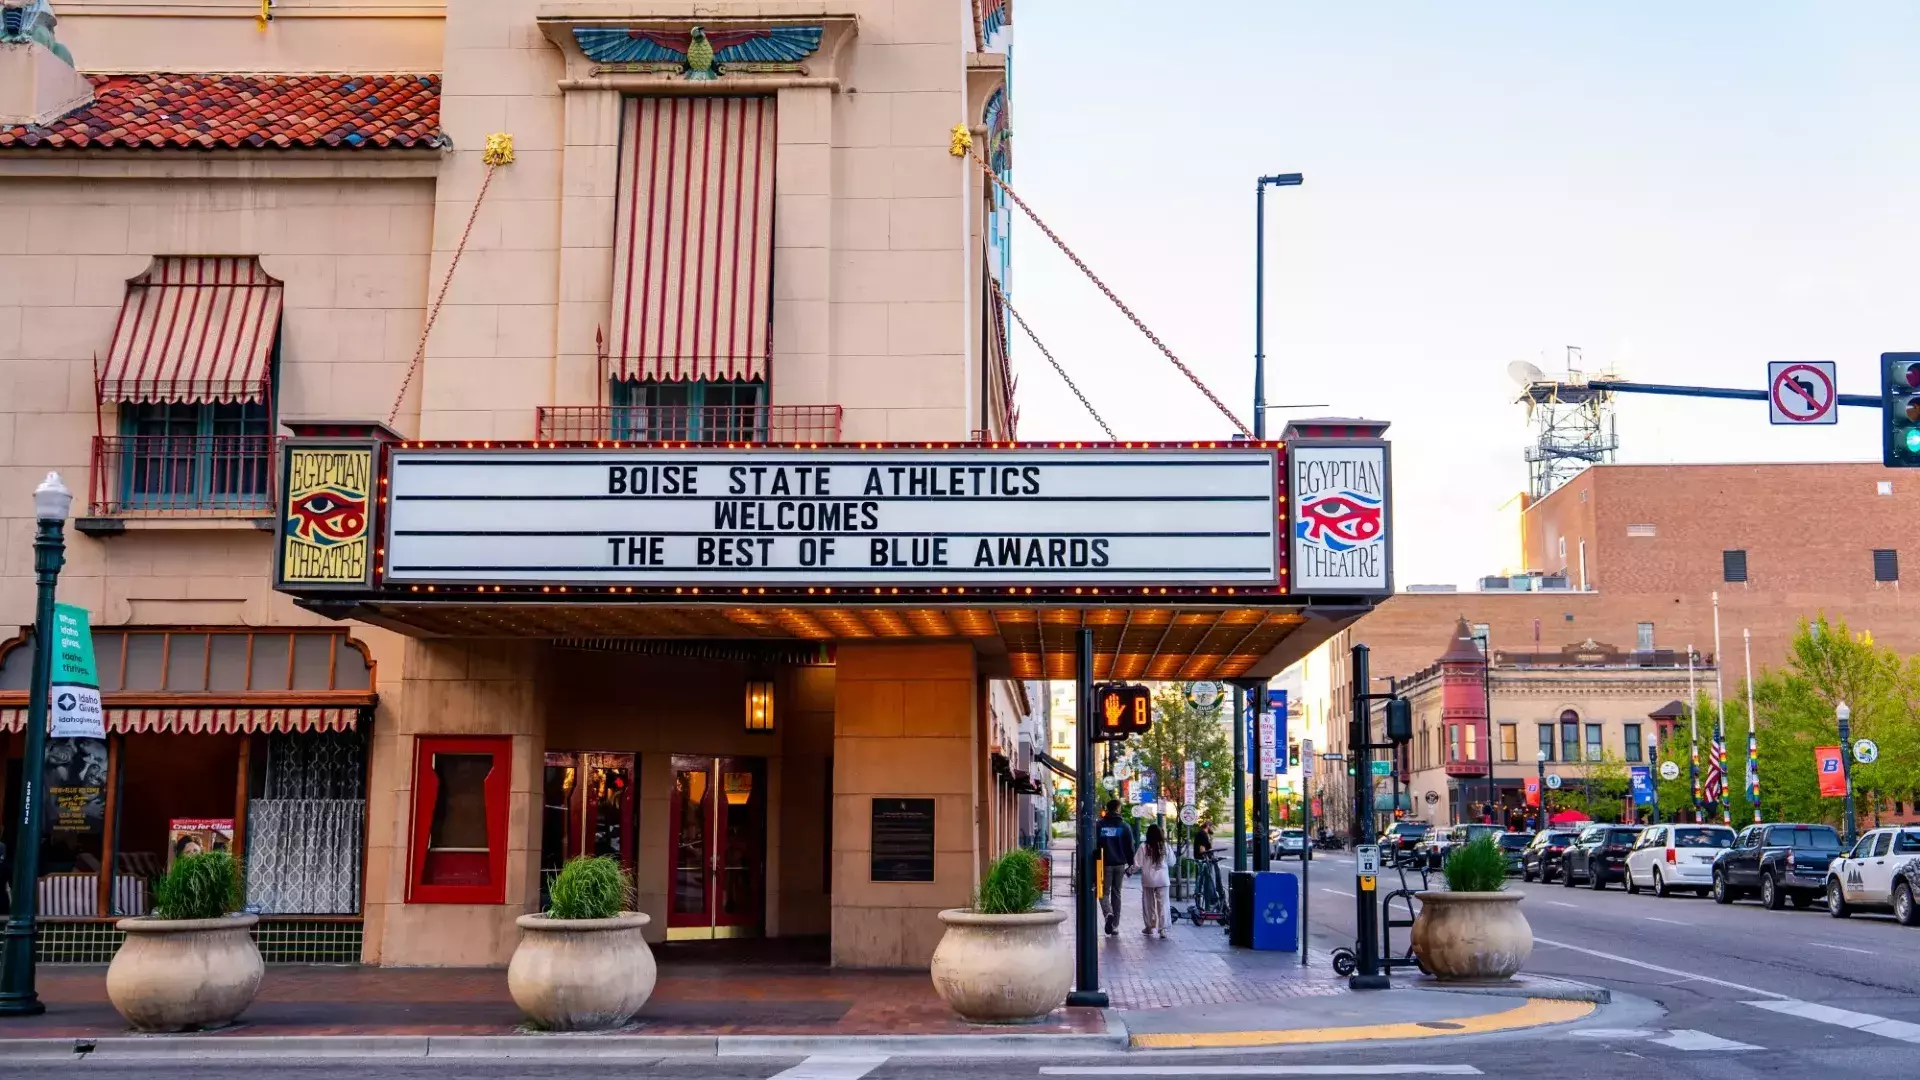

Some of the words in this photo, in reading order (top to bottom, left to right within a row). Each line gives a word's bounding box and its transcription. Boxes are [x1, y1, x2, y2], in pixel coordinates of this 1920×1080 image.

[291, 453, 370, 493] EGYPTIAN
[609, 466, 698, 495] BOISE
[729, 466, 831, 496] STATE
[863, 466, 1040, 496] ATHLETICS
[1297, 460, 1381, 497] EGYPTIAN
[714, 501, 879, 531] WELCOMES
[290, 540, 364, 579] THEATRE
[608, 537, 665, 566] THE
[697, 537, 775, 566] BEST
[799, 538, 836, 567] OF
[870, 538, 948, 567] BLUE
[974, 538, 1109, 567] AWARDS
[1303, 543, 1379, 578] THEATRE
[59, 614, 76, 626] When
[62, 664, 89, 675] thrives.
[78, 693, 98, 704] Idaho
[79, 703, 99, 714] Gives
[1135, 697, 1147, 724] 8
[58, 716, 101, 727] idahogives.org
[1822, 758, 1839, 773] B
[172, 823, 196, 831] Crazy
